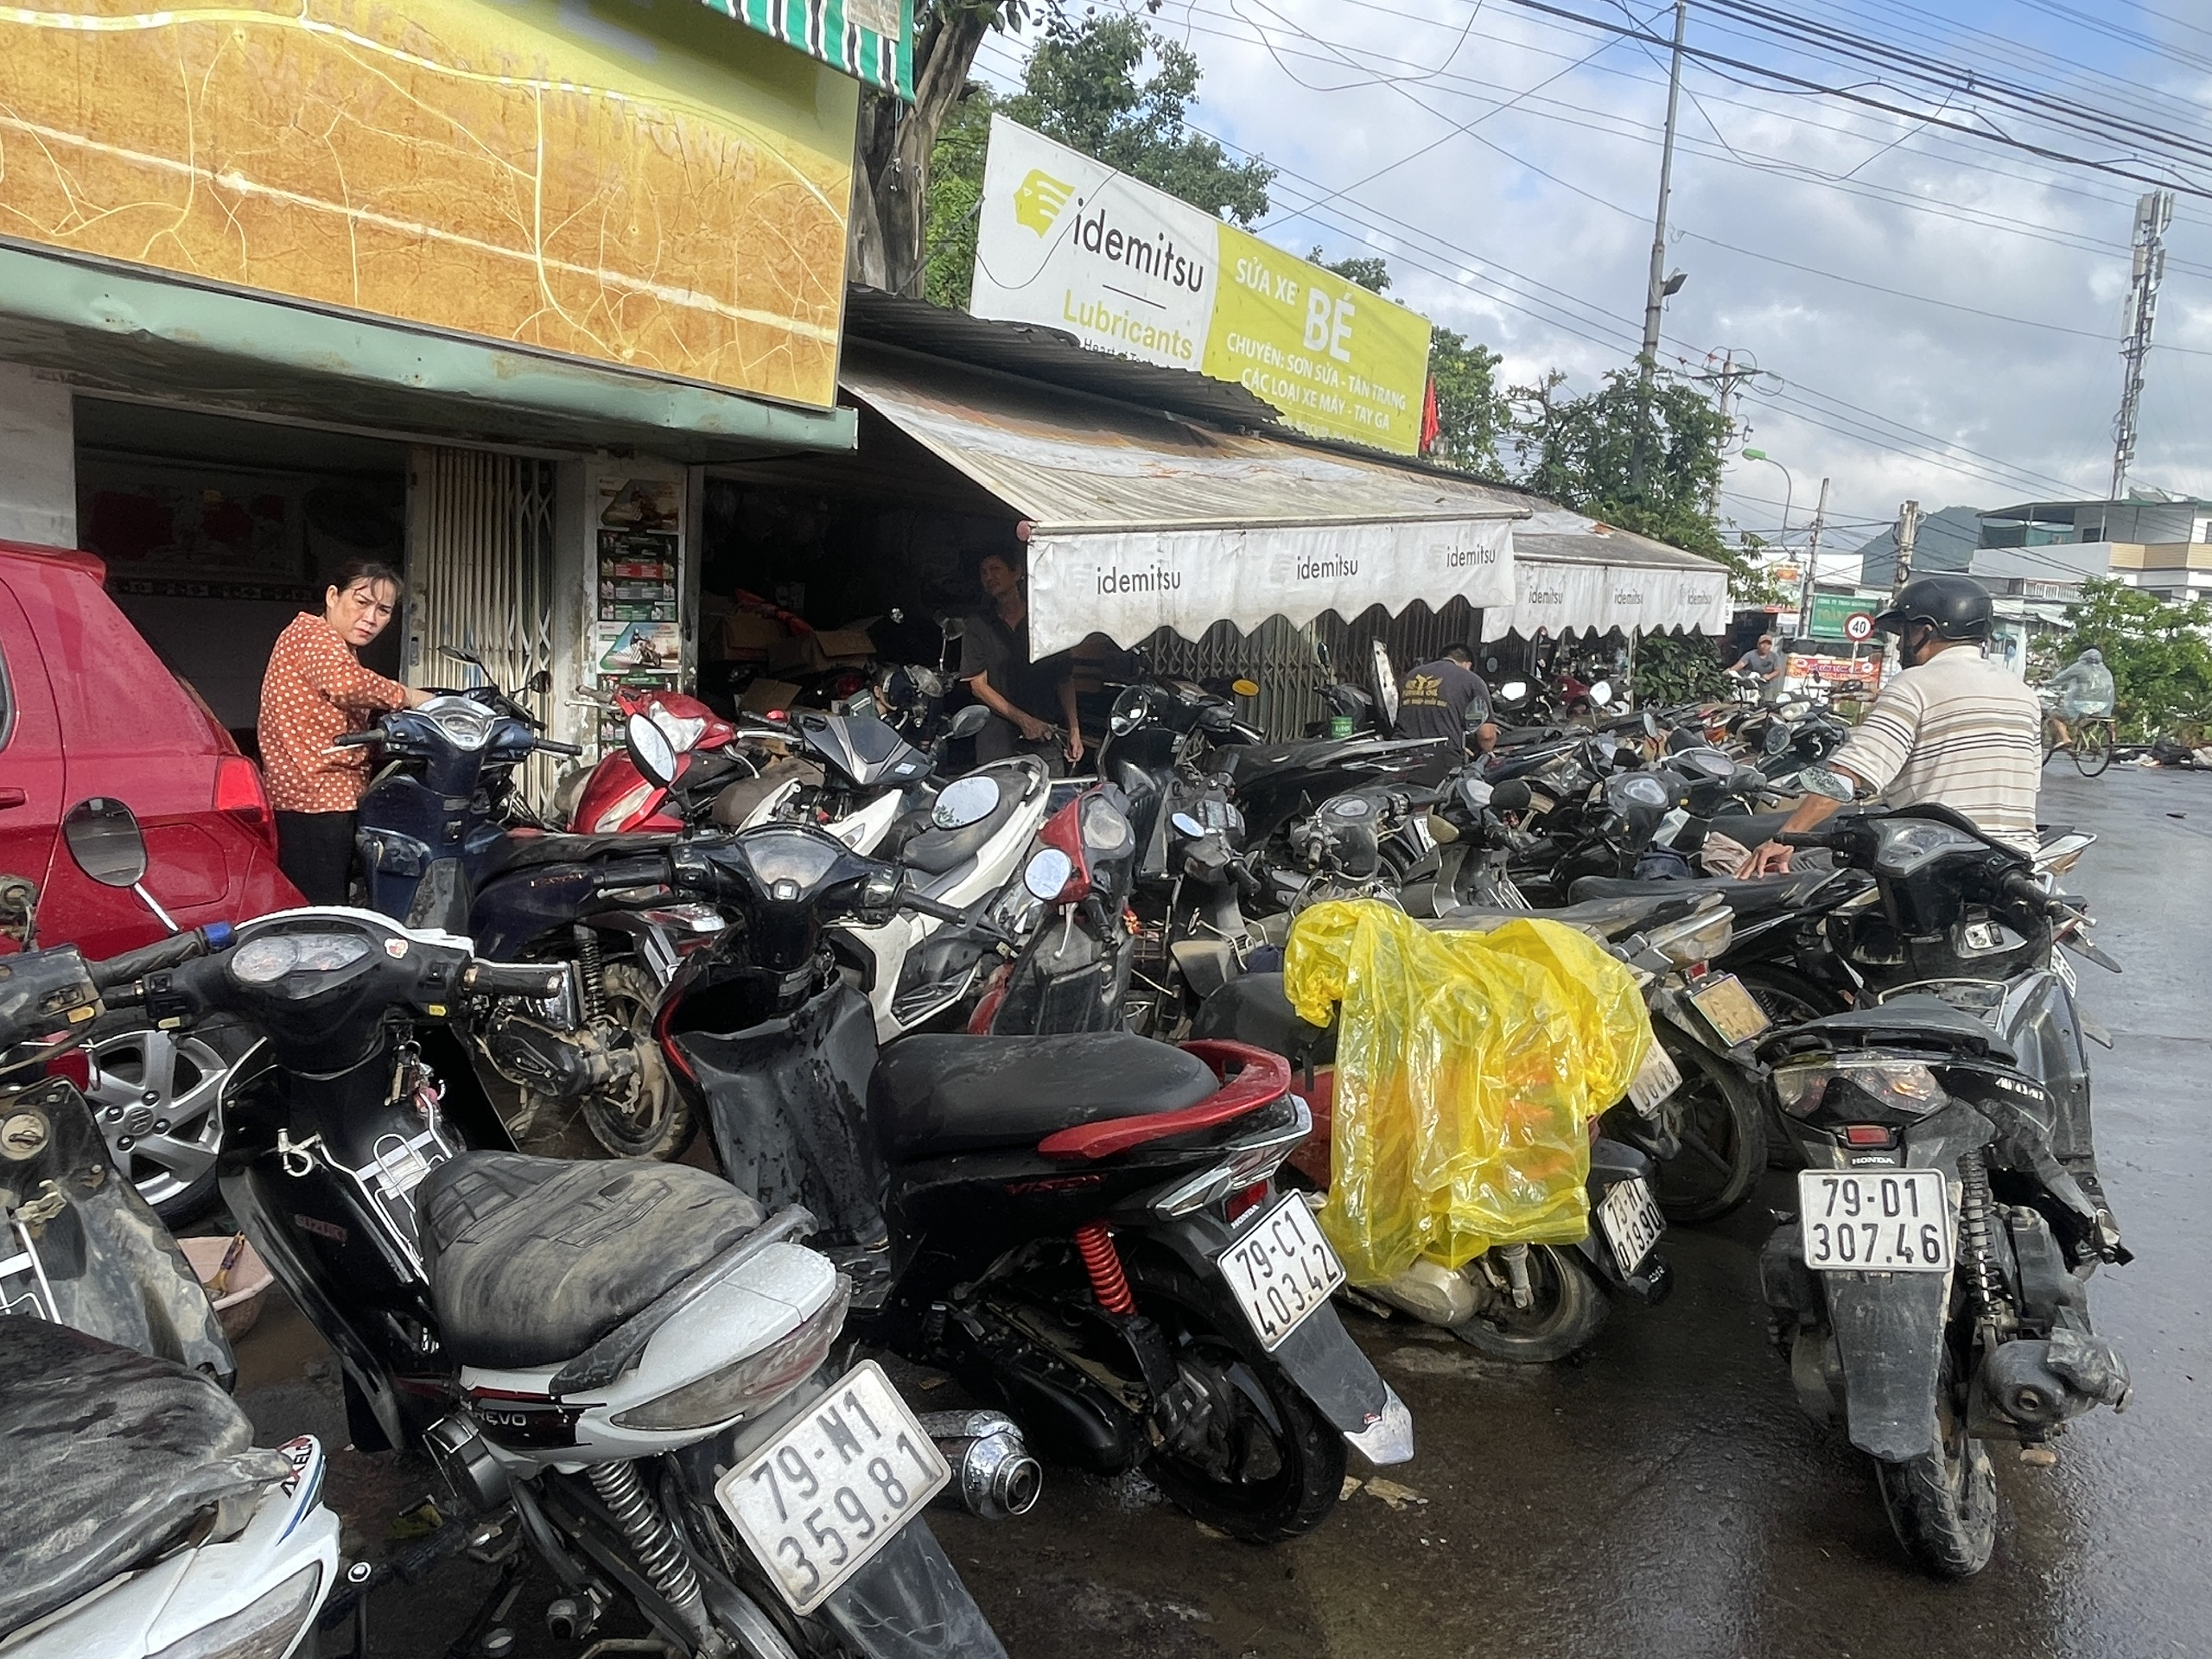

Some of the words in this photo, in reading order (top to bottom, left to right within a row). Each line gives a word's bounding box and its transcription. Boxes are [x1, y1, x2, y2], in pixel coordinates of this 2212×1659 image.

[1073, 198, 1204, 292] idemitsu
[1236, 257, 1270, 296] SỬA
[1274, 275, 1297, 306] XE
[1064, 289, 1193, 360] Lubricants
[1303, 287, 1356, 363] BÉ
[1271, 377, 1300, 405] LOẠI
[1302, 389, 1317, 408] XE
[1319, 395, 1346, 415] MÁY
[1354, 404, 1373, 425] TAY
[1375, 413, 1389, 431] GA
[1370, 385, 1406, 410] TRANG
[1296, 556, 1358, 580] idemitsu
[1446, 543, 1496, 569] idemitsu
[1096, 564, 1181, 595] idemitsu
[1853, 620, 1866, 634] 40
[1852, 1156, 1895, 1165] HONDA
[1230, 1205, 1260, 1230] HONDA
[1822, 1178, 1918, 1217] 79-D1
[1235, 1210, 1306, 1291] 79-C1
[1813, 1224, 1941, 1263] 307.46
[1255, 1244, 1338, 1337] 403.42
[749, 1389, 881, 1523] 79-N1
[777, 1431, 942, 1594] 359.81
